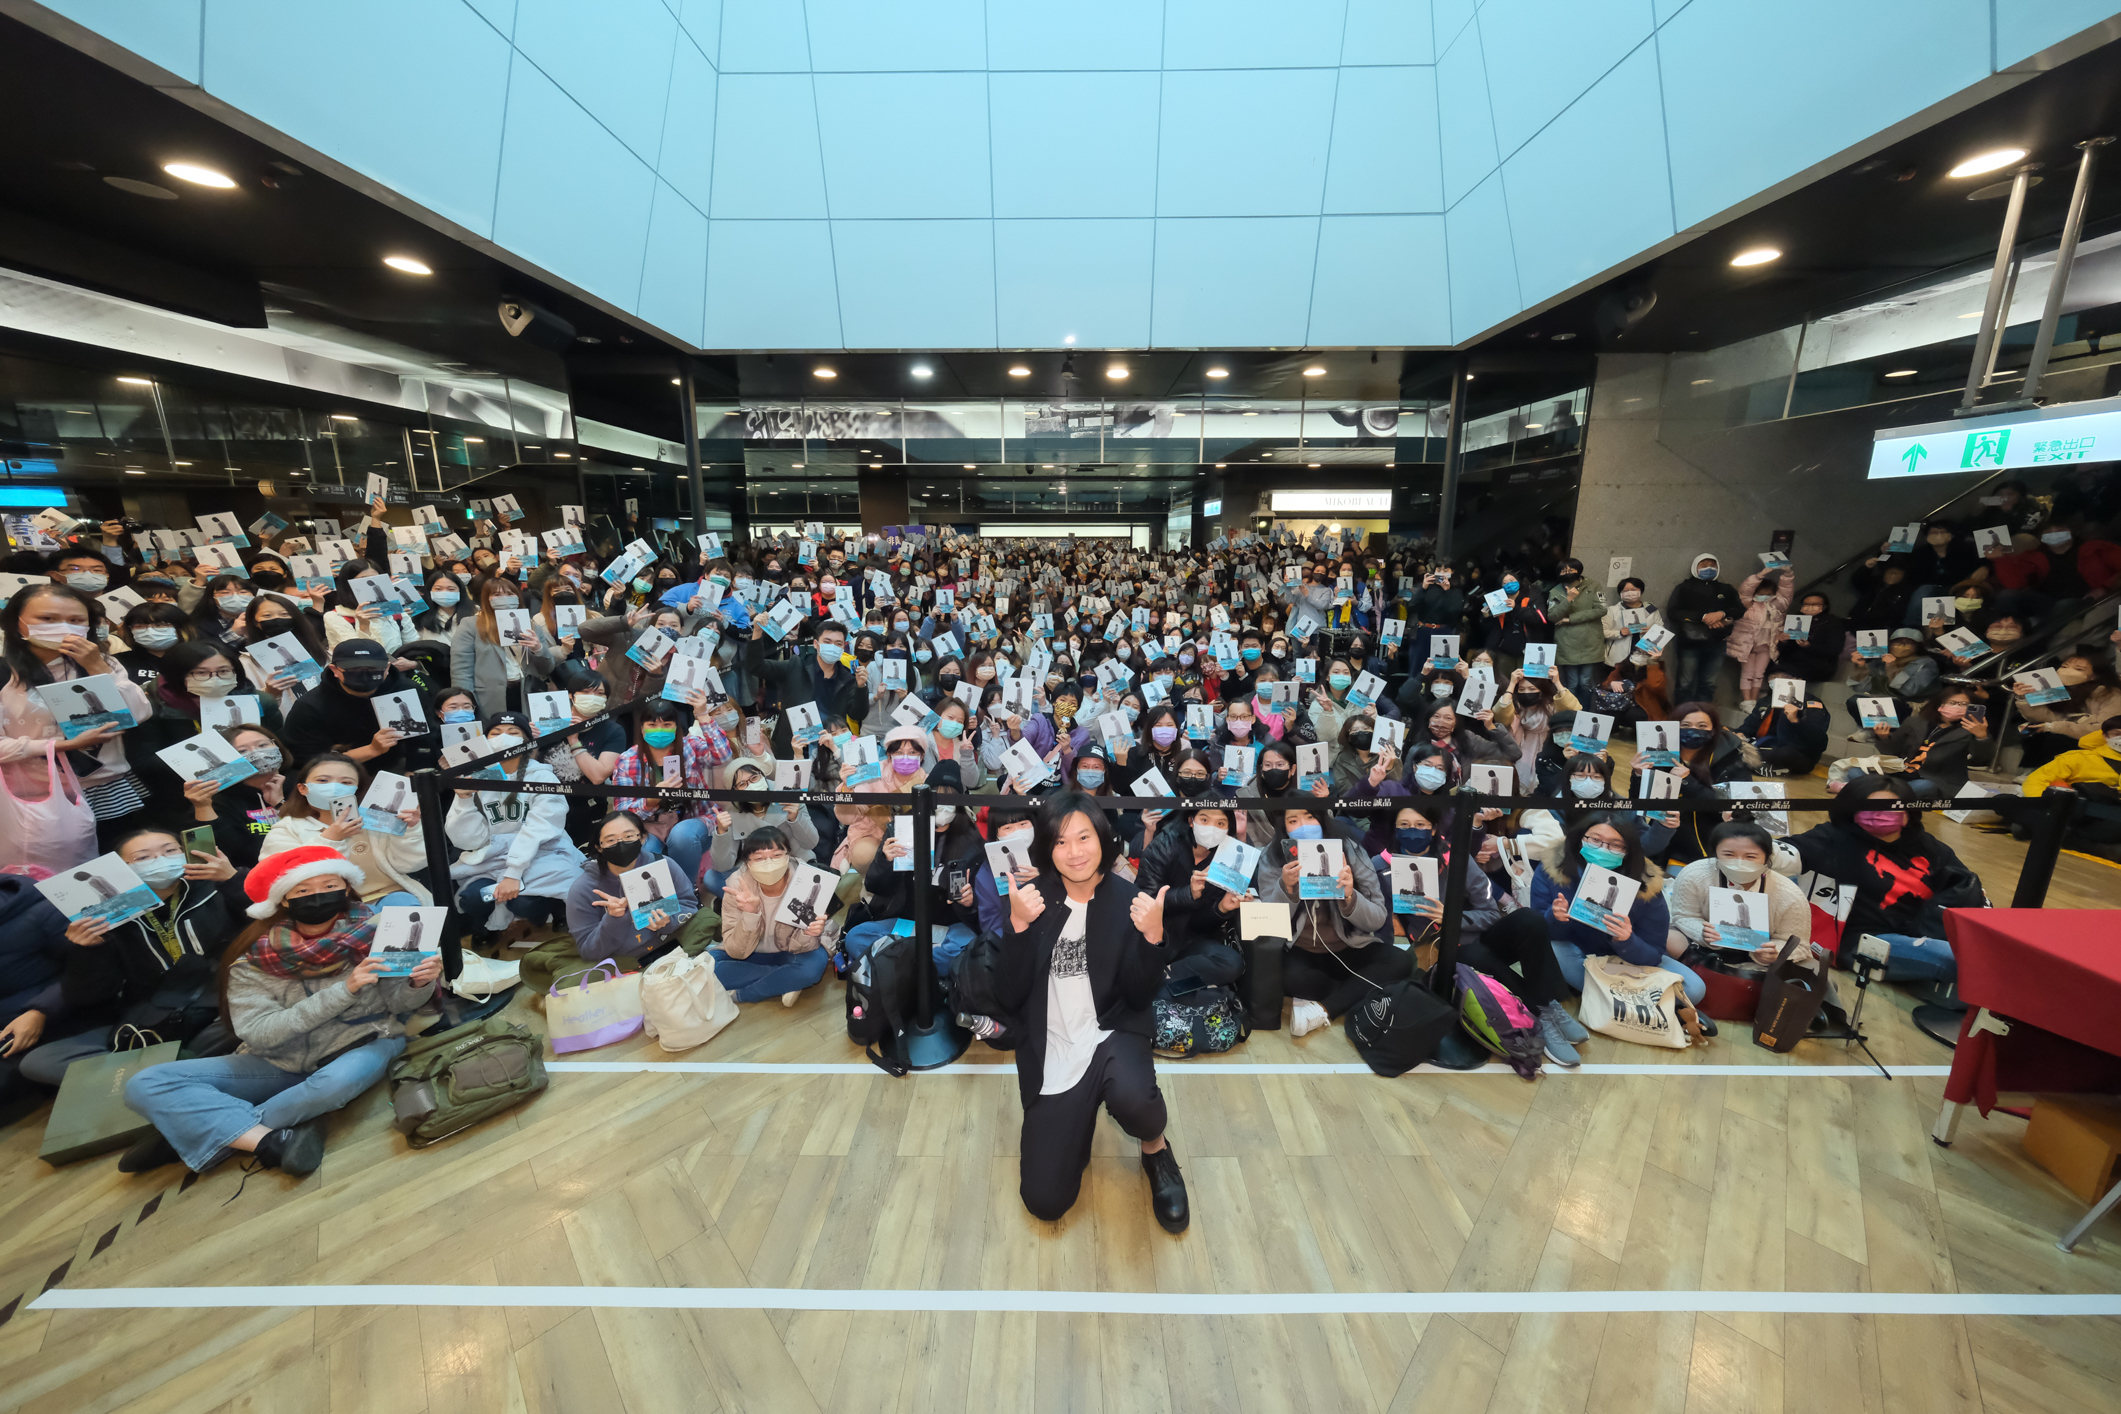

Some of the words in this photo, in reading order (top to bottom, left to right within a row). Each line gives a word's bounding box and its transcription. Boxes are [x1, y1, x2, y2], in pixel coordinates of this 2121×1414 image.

[2032, 436, 2096, 453] 緊急出口
[2032, 450, 2090, 463] EXIT
[511, 744, 527, 756] eslite
[526, 740, 538, 752] 誠品
[535, 784, 555, 792] eslite
[556, 784, 573, 794] 誠品
[671, 790, 692, 798] eslite
[693, 790, 711, 799] 誠品
[812, 793, 835, 801] eslite
[835, 793, 853, 803] 誠品
[1195, 799, 1218, 808] eslite
[1219, 799, 1238, 808] 誠品
[1348, 799, 1372, 807] eslite
[1373, 798, 1392, 807] 誠品
[1589, 801, 1612, 809] eslite
[1613, 800, 1633, 809] 誠品
[1745, 800, 1770, 809] eslite
[1770, 800, 1791, 810] 誠品
[1906, 800, 1931, 809] eslite
[1932, 799, 1952, 809] 誠品
[562, 1006, 607, 1026] Heather
